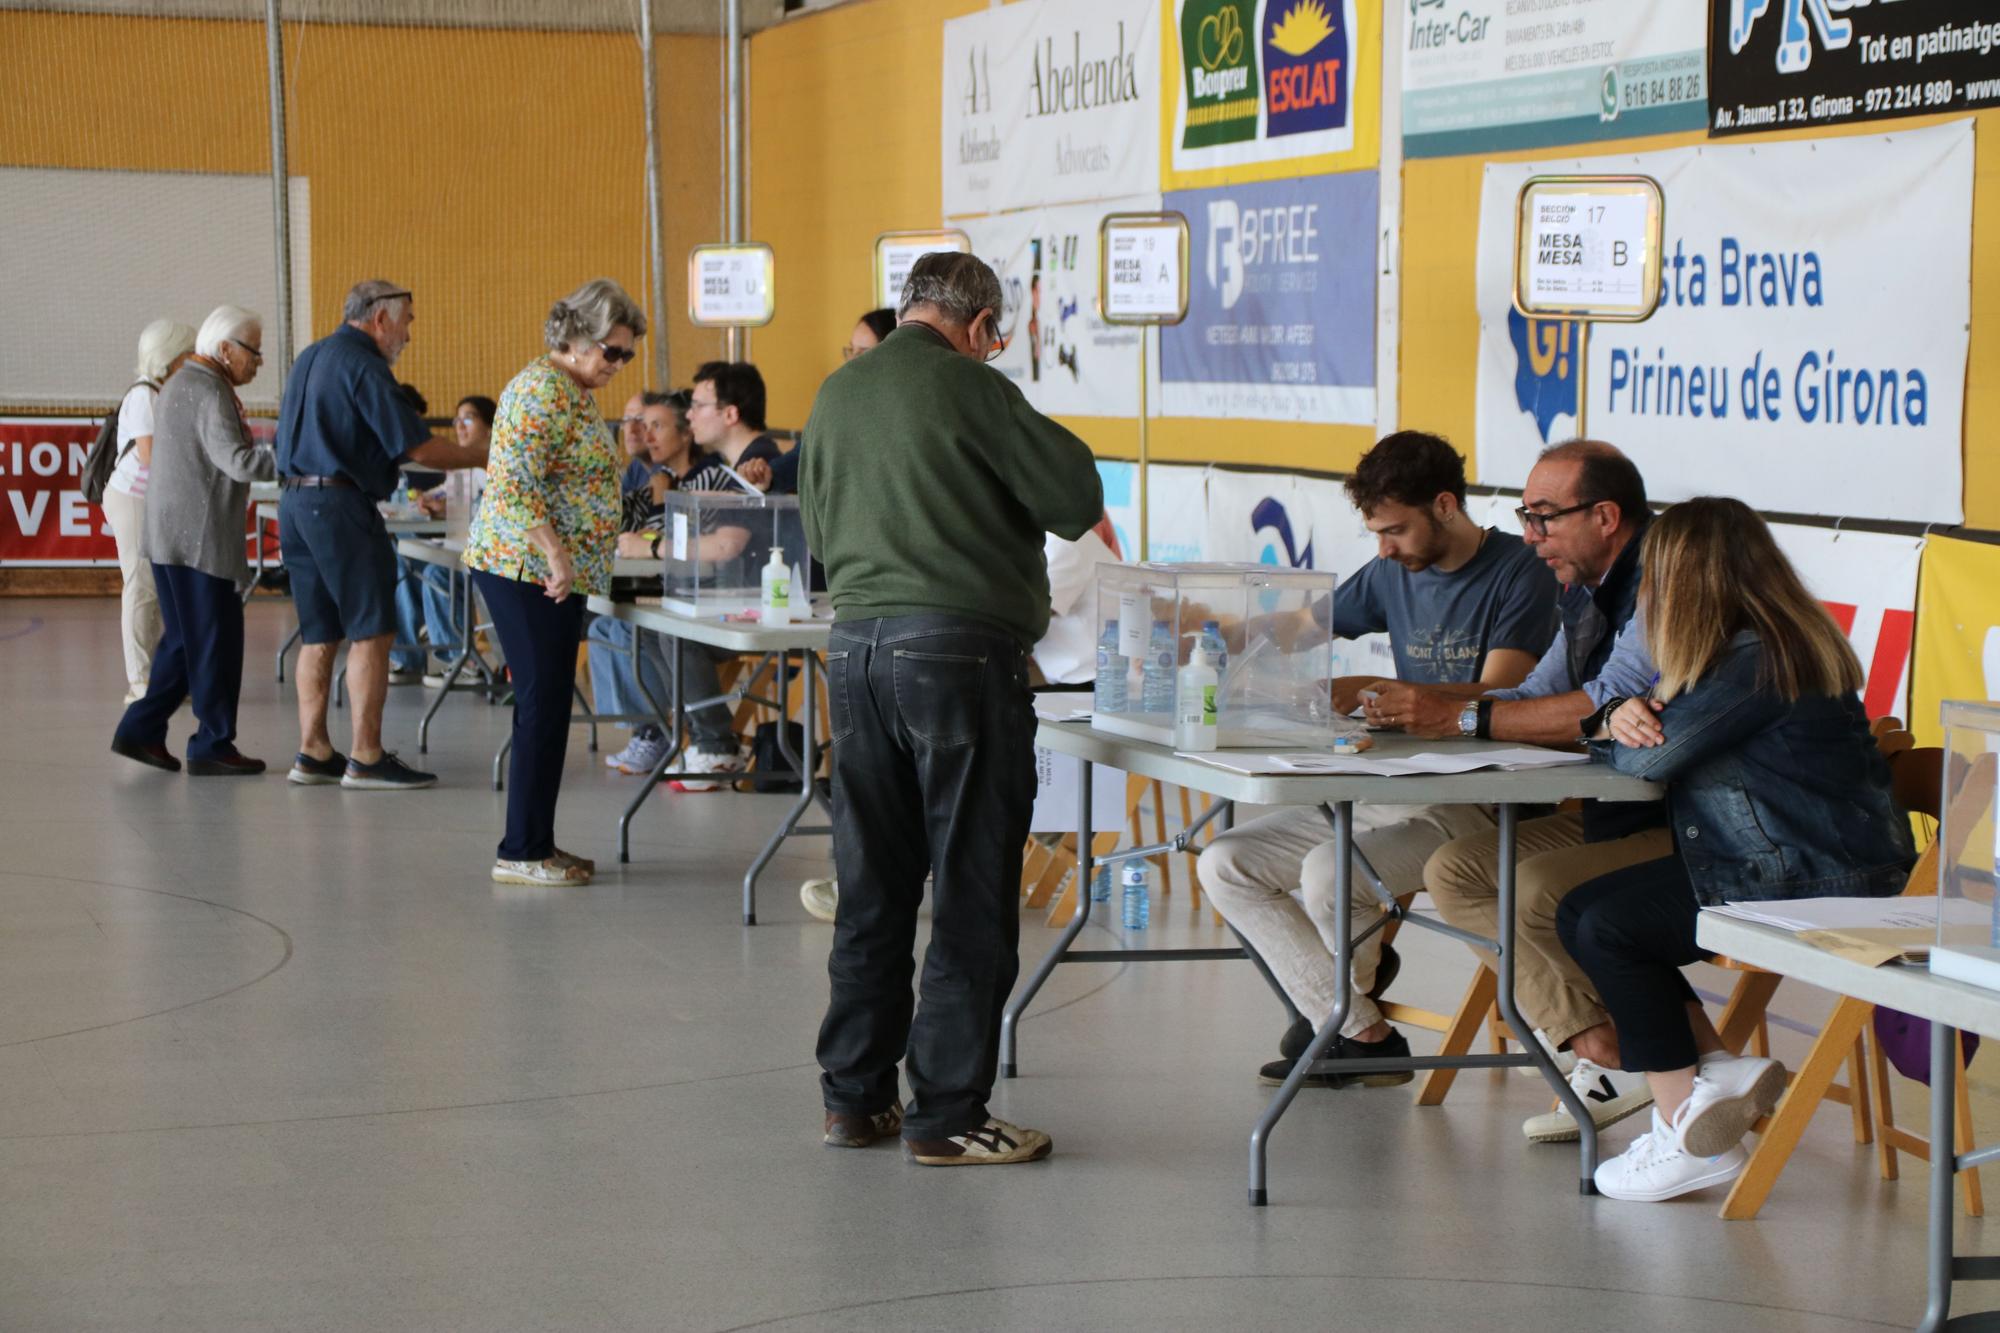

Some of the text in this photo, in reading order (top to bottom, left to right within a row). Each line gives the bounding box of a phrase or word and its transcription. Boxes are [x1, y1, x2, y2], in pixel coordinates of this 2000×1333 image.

[1409, 11, 1491, 50] Inter-Car
[1858, 20, 2000, 64] Tot en patinatge
[1025, 20, 1139, 118] Abelenda
[1191, 65, 1249, 100] Bonpreu
[1268, 59, 1340, 114] ESCLAT
[1624, 72, 1700, 106] 616 84 88 26
[1714, 105, 1735, 129] Av.
[1737, 104, 1777, 127] Jaume
[1777, 100, 1787, 122] I
[1788, 99, 1808, 122] 32,
[1810, 93, 1854, 118] Girona
[1864, 87, 1892, 113] 972
[1894, 83, 1922, 109] 214
[1924, 79, 1953, 105] 980
[1588, 206, 1606, 224] 17
[1241, 204, 1319, 265] BFREE
[1539, 233, 1583, 248] MESA
[1538, 250, 1583, 265] MESA
[1613, 240, 1628, 267] B
[1721, 237, 1823, 307] Brava
[1158, 263, 1169, 282] A
[1609, 346, 1928, 426] Pirineu de Girona
[0, 442, 93, 477] ION
